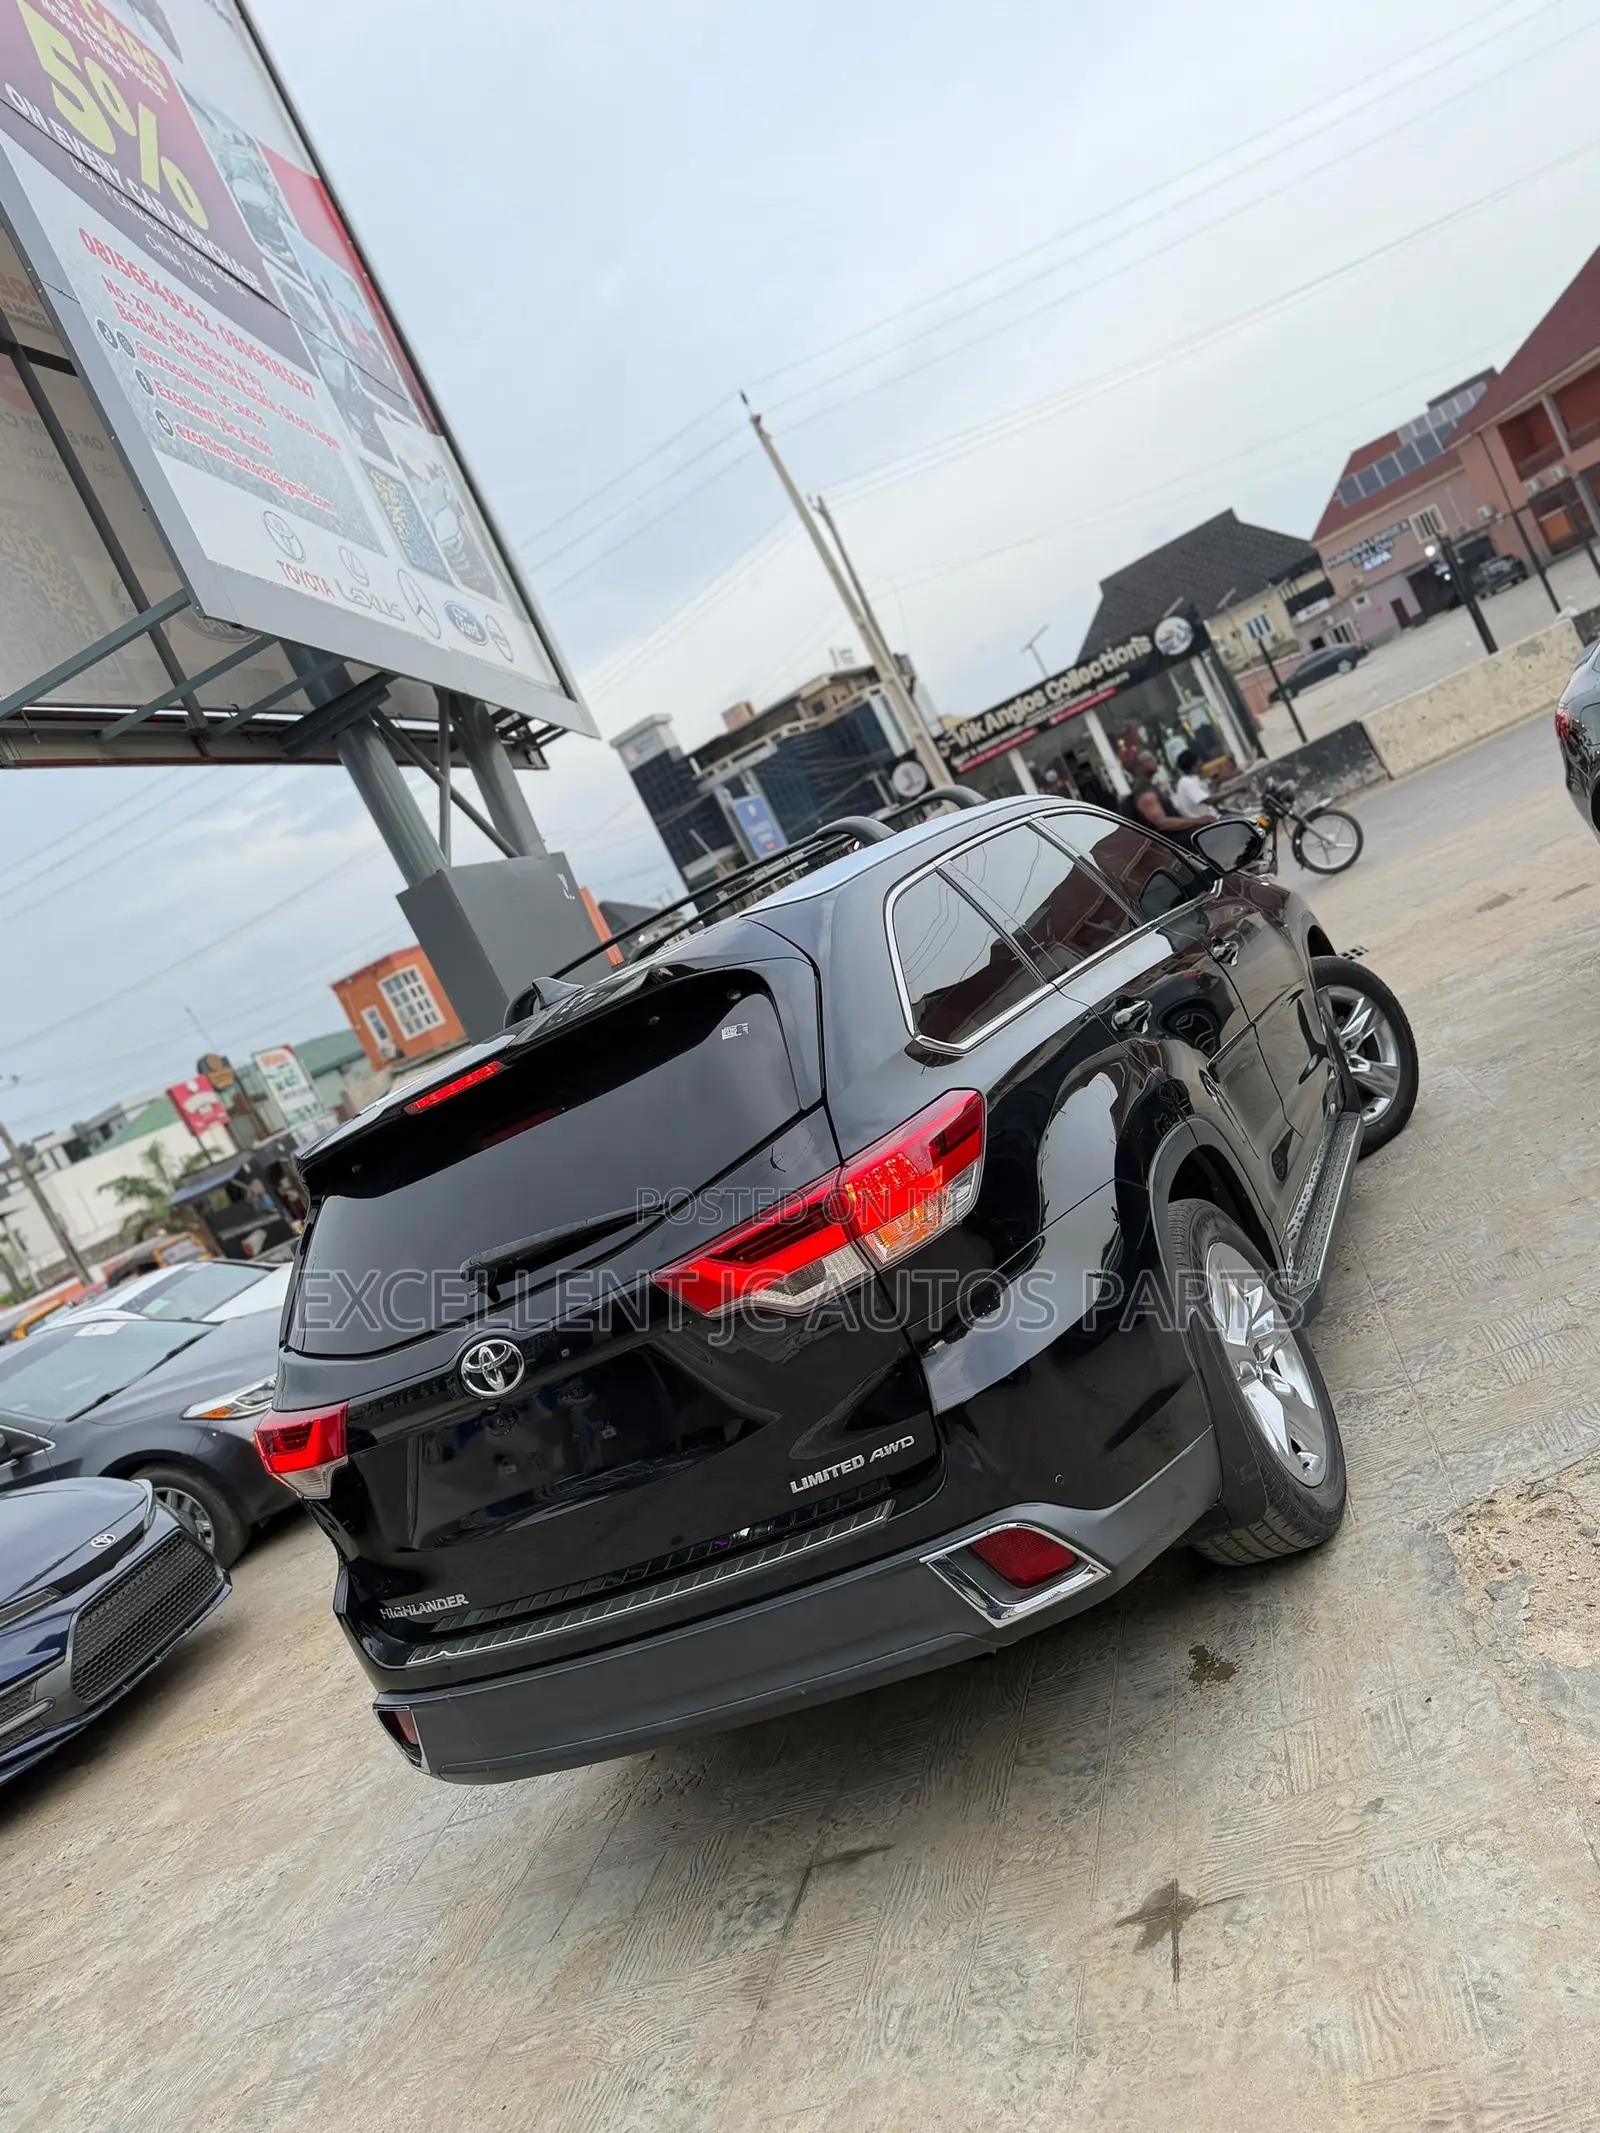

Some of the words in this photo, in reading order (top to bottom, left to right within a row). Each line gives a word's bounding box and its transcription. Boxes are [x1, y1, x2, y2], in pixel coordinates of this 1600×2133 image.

[17, 0, 208, 231] 5%
[4, 82, 51, 135] ON
[48, 116, 125, 190] EVERY
[126, 177, 175, 228] CAR
[168, 209, 266, 299] PURCHASE
[69, 154, 102, 189] USA
[144, 232, 186, 271] CHINA
[113, 299, 169, 346] Beside
[129, 293, 158, 321] 210
[276, 559, 336, 599] TOYOTA
[334, 578, 406, 622] LEXUS
[789, 1454, 866, 1494] LIMITED
[868, 1435, 916, 1463] AWD
[379, 1593, 470, 1620] HIGHLANDER
